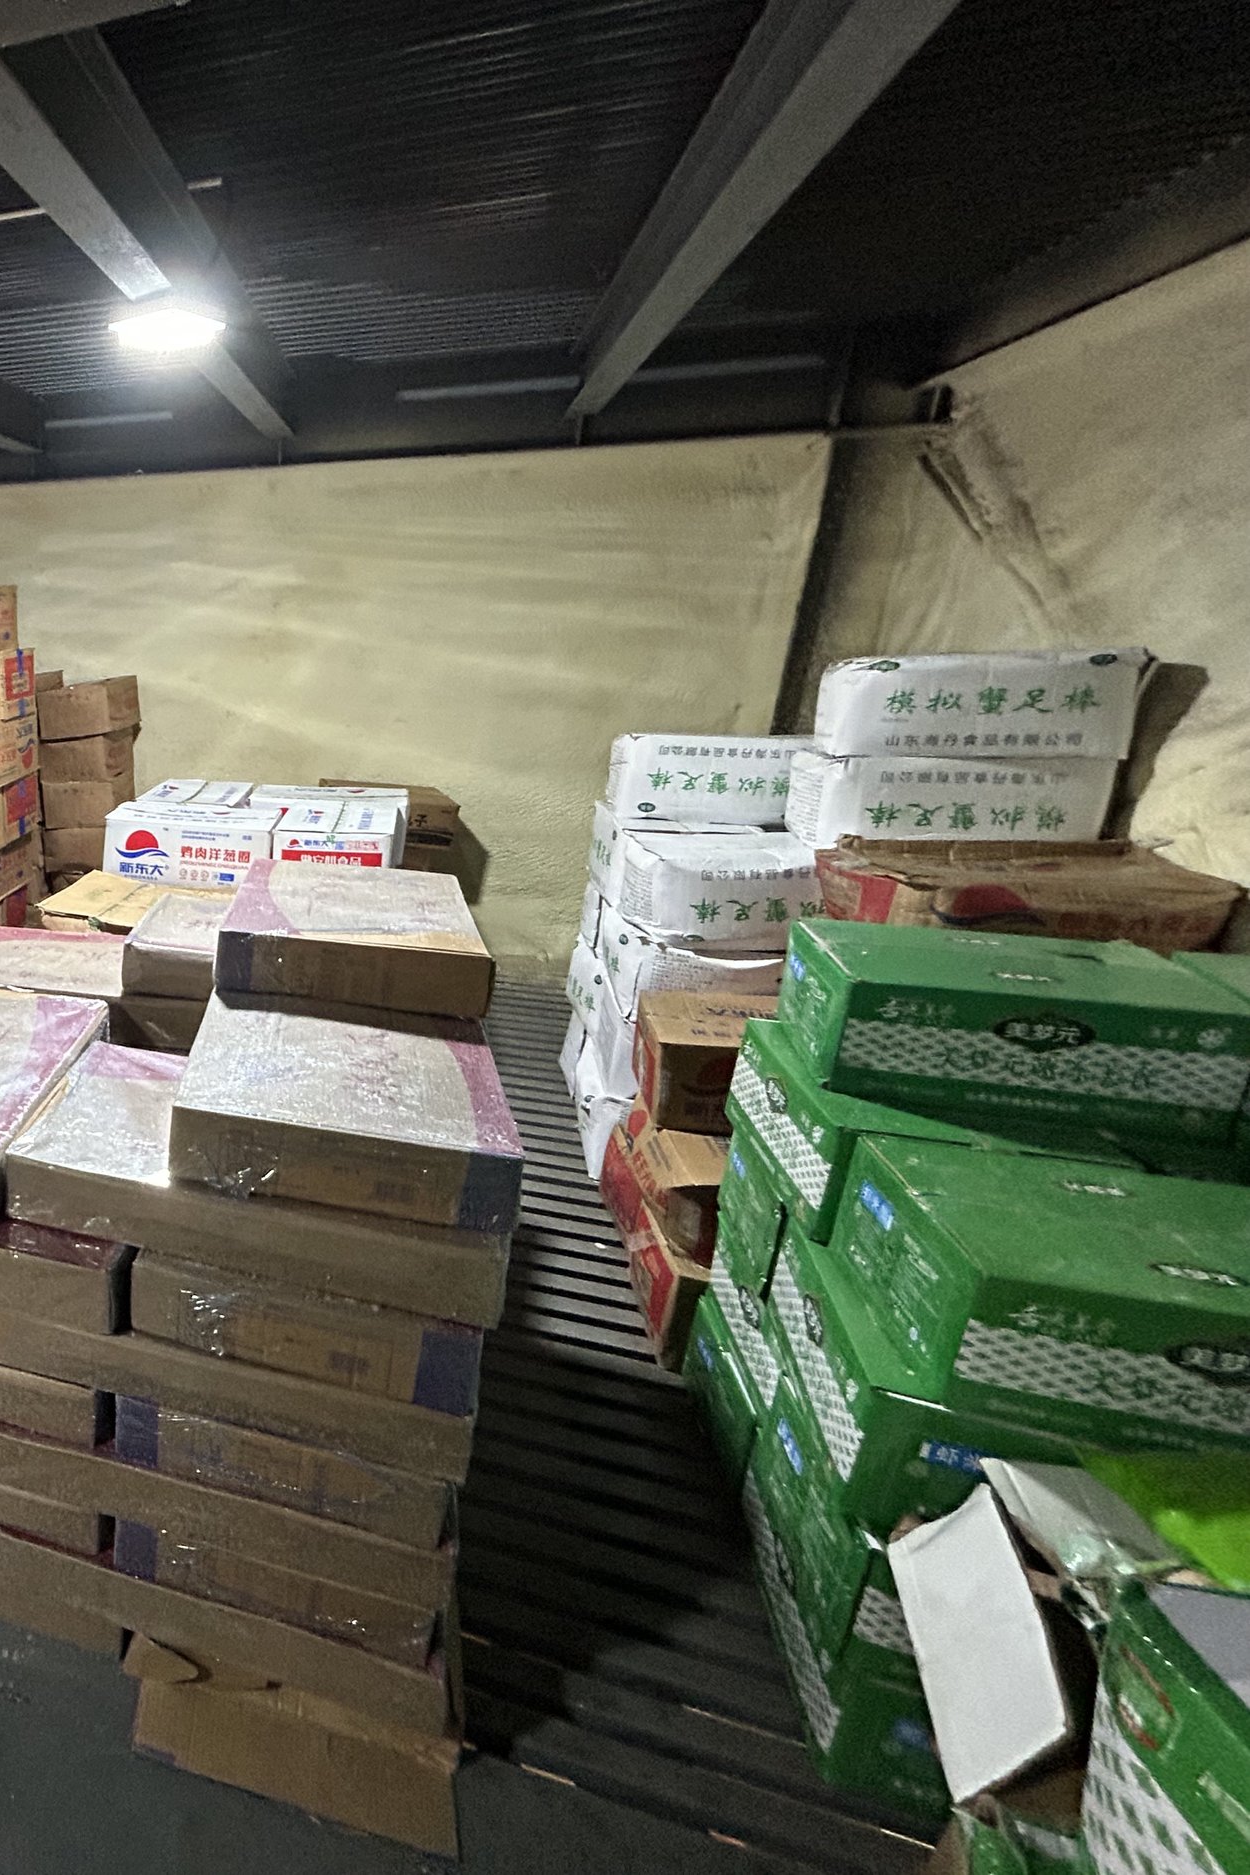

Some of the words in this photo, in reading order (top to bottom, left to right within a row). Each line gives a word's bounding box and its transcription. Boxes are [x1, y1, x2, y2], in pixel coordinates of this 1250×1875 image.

[886, 685, 1100, 714] 模拟蟹足棒
[181, 846, 250, 863] 鸭肉洋葱圈
[119, 862, 164, 876] 新东大
